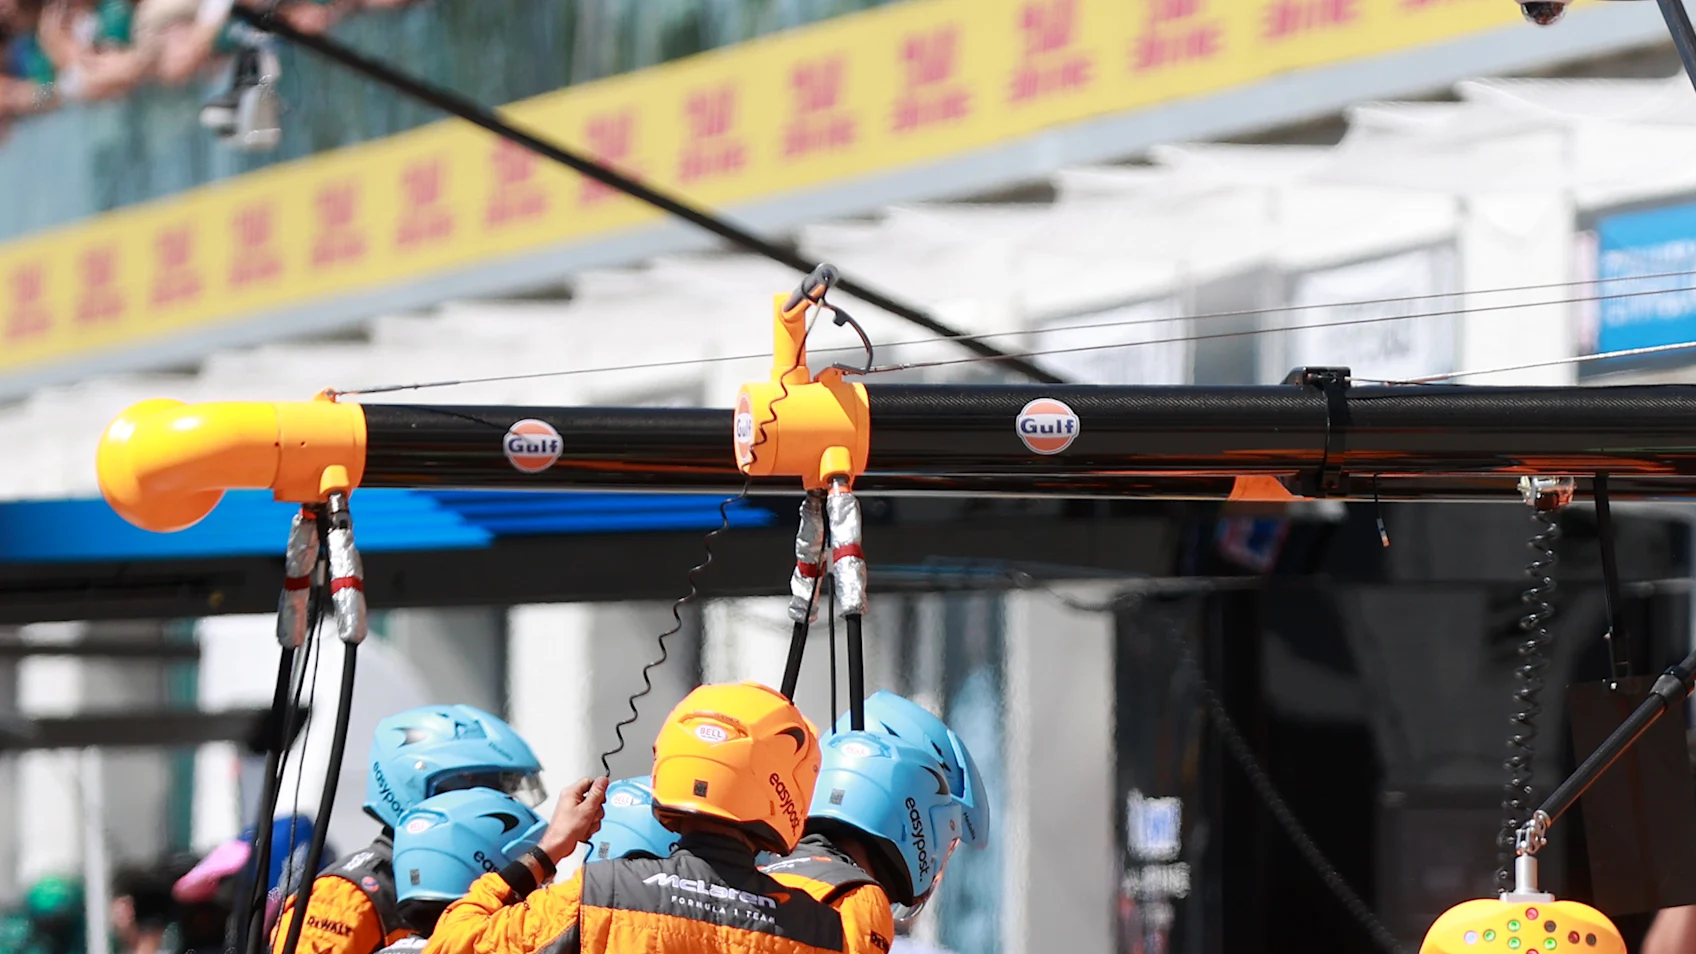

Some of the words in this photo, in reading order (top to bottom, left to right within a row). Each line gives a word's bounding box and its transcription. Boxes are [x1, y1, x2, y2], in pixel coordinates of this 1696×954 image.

[1019, 415, 1076, 437] Gulf
[507, 437, 559, 454] Gulf
[699, 726, 723, 740] BELL
[769, 771, 801, 838] easypost.
[904, 796, 931, 883] easypost.
[642, 872, 778, 910] McLaren
[670, 895, 727, 915] FORMULA
